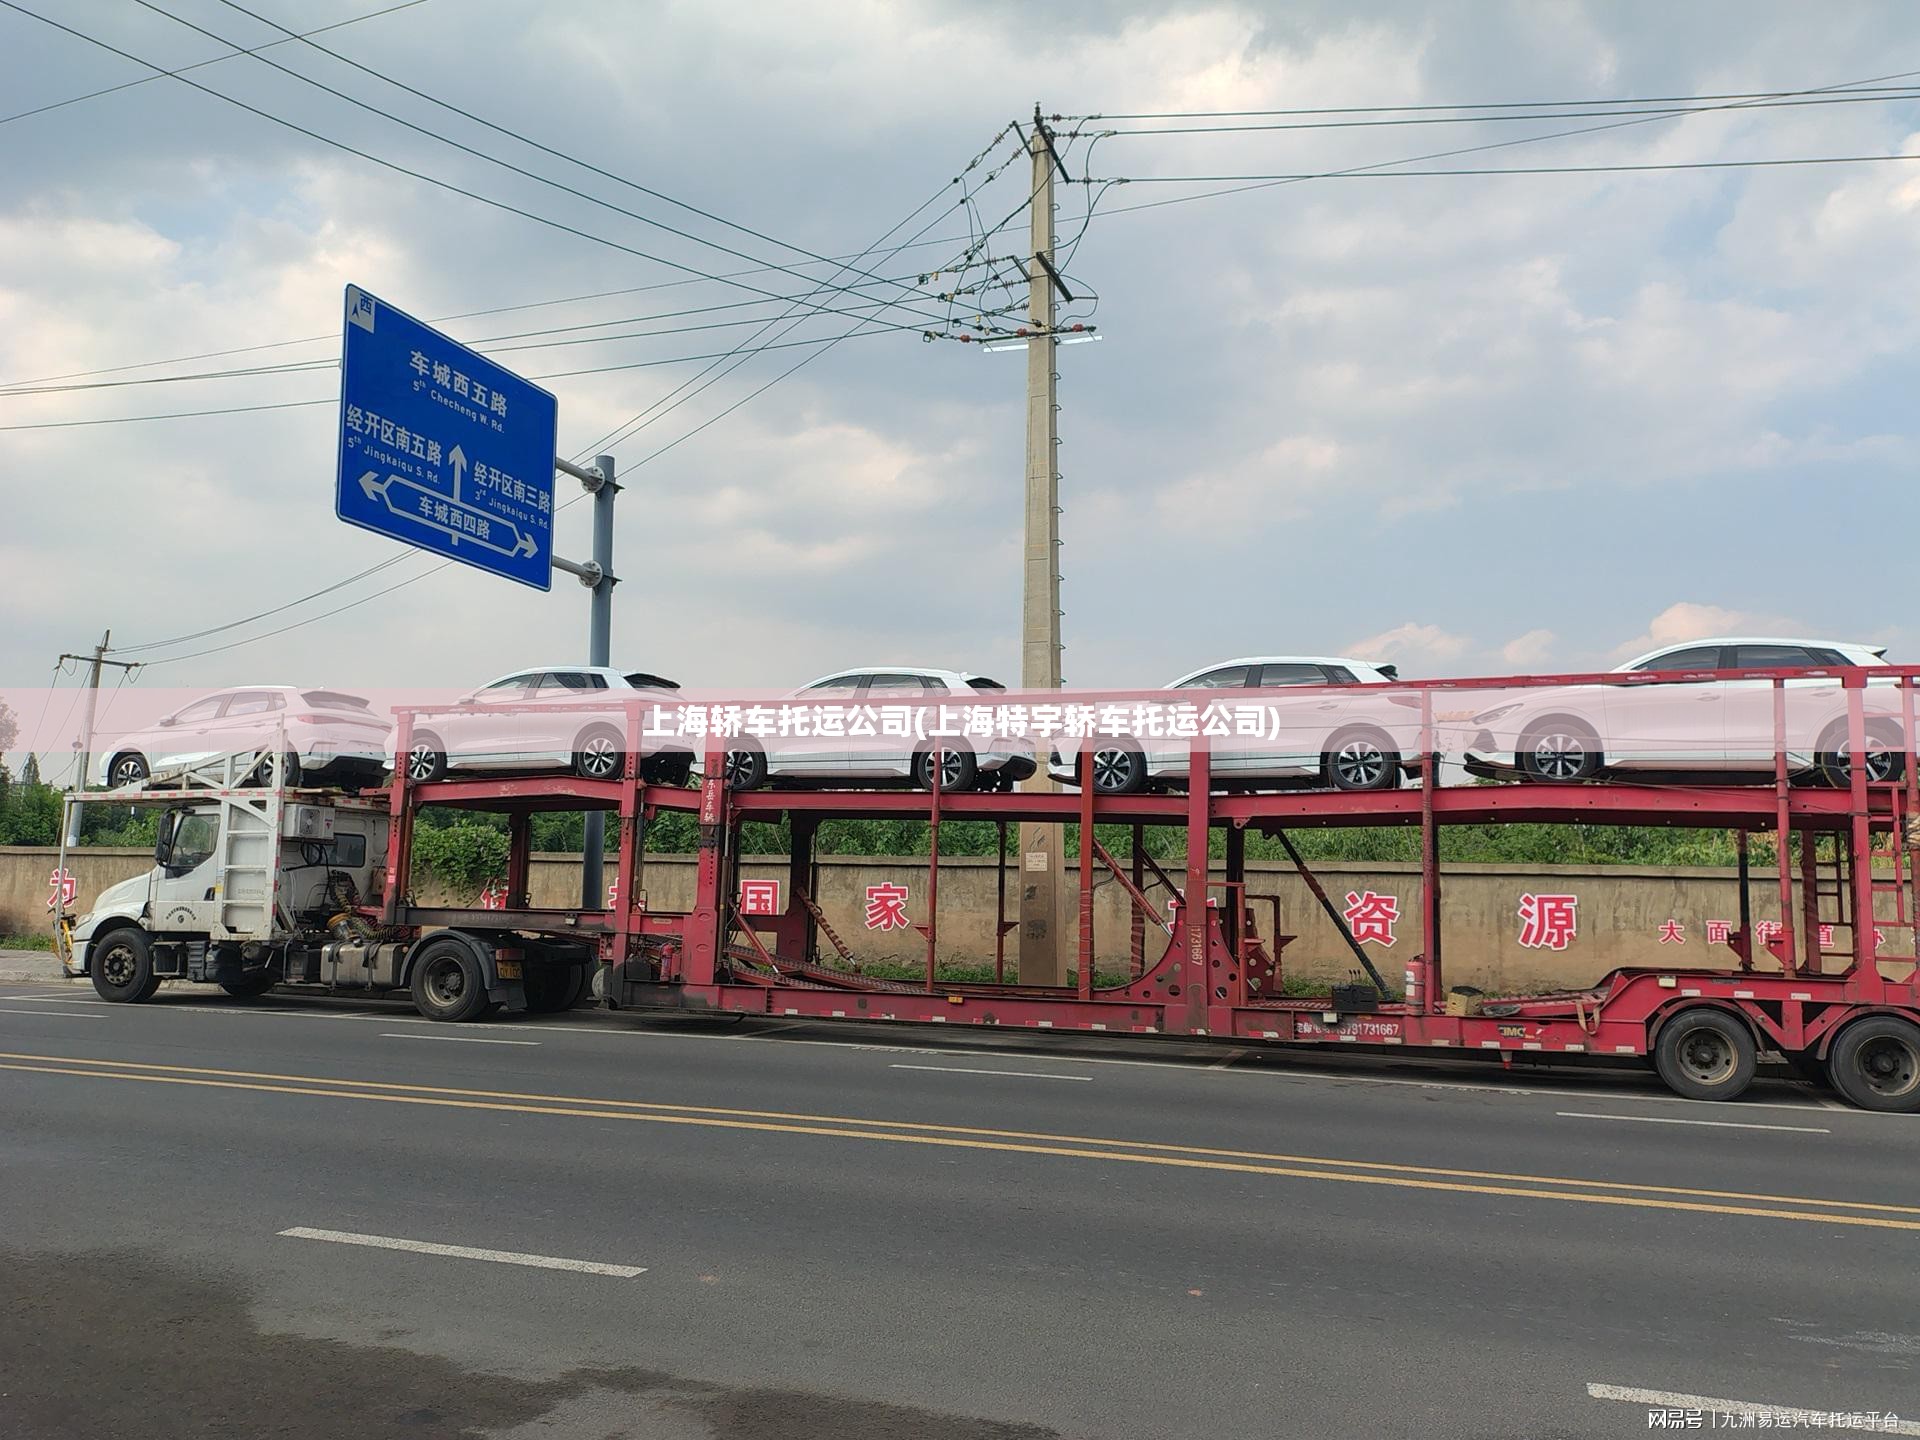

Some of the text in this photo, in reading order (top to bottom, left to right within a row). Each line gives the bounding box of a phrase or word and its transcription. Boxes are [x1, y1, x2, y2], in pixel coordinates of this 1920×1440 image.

[360, 295, 373, 315] 西
[409, 350, 508, 418] 车城西五路
[431, 389, 477, 422] Checheng
[491, 420, 505, 434] Rd.
[346, 403, 442, 467] 经开区南五路
[363, 443, 413, 475] Jingkaiqu
[427, 471, 441, 485] Rd.
[473, 461, 550, 515] 经开区南三路
[488, 497, 528, 523] Jingkaiqu
[419, 495, 490, 541] 车城西四路
[1518, 893, 1578, 950] 源
